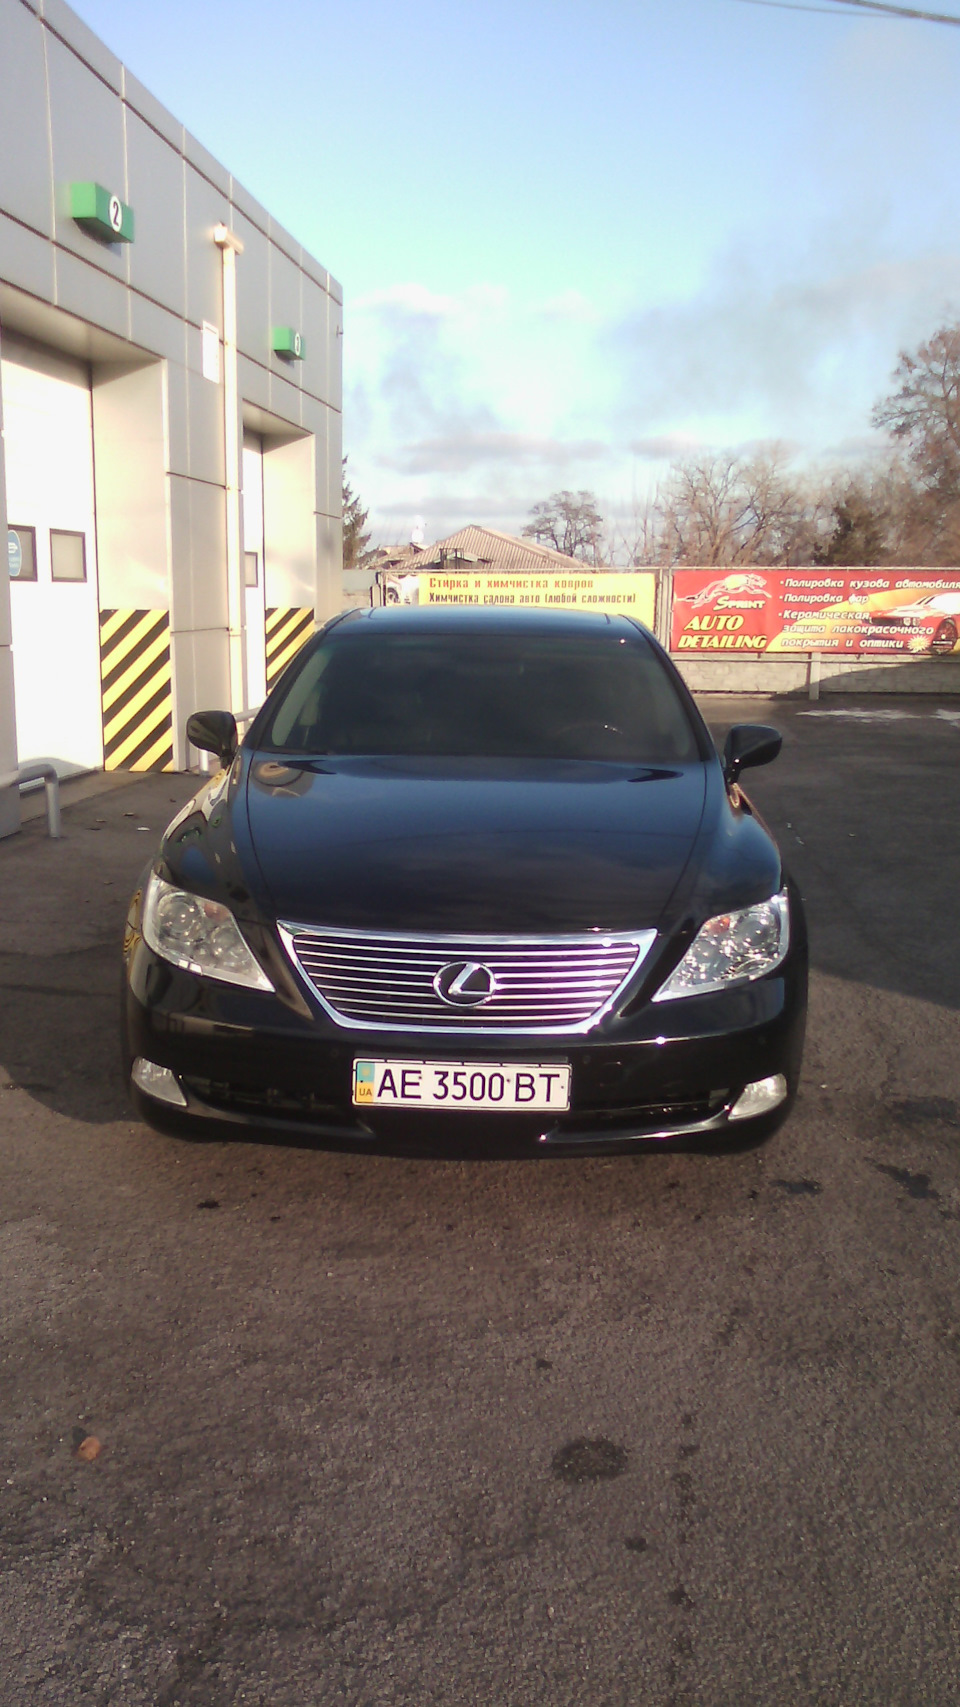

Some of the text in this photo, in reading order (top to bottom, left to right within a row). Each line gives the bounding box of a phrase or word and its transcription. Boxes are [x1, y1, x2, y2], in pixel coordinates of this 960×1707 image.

[112, 201, 119, 226] 2
[429, 577, 469, 590] Стирка
[487, 580, 548, 588] химчистка
[785, 578, 844, 589] Полировка
[849, 579, 890, 590] кузова
[429, 593, 479, 603] Химчистка
[484, 594, 515, 605] салона
[519, 595, 540, 604] авто
[783, 594, 869, 605] Полировка фар
[683, 615, 744, 631] AUTO
[782, 625, 934, 636] защита лакокрасочного
[677, 635, 767, 648] DETAILING
[781, 639, 839, 648] покрытия
[859, 640, 904, 648] оптики
[377, 1069, 560, 1103] AE 3500 BT
[358, 1088, 373, 1097] UA
